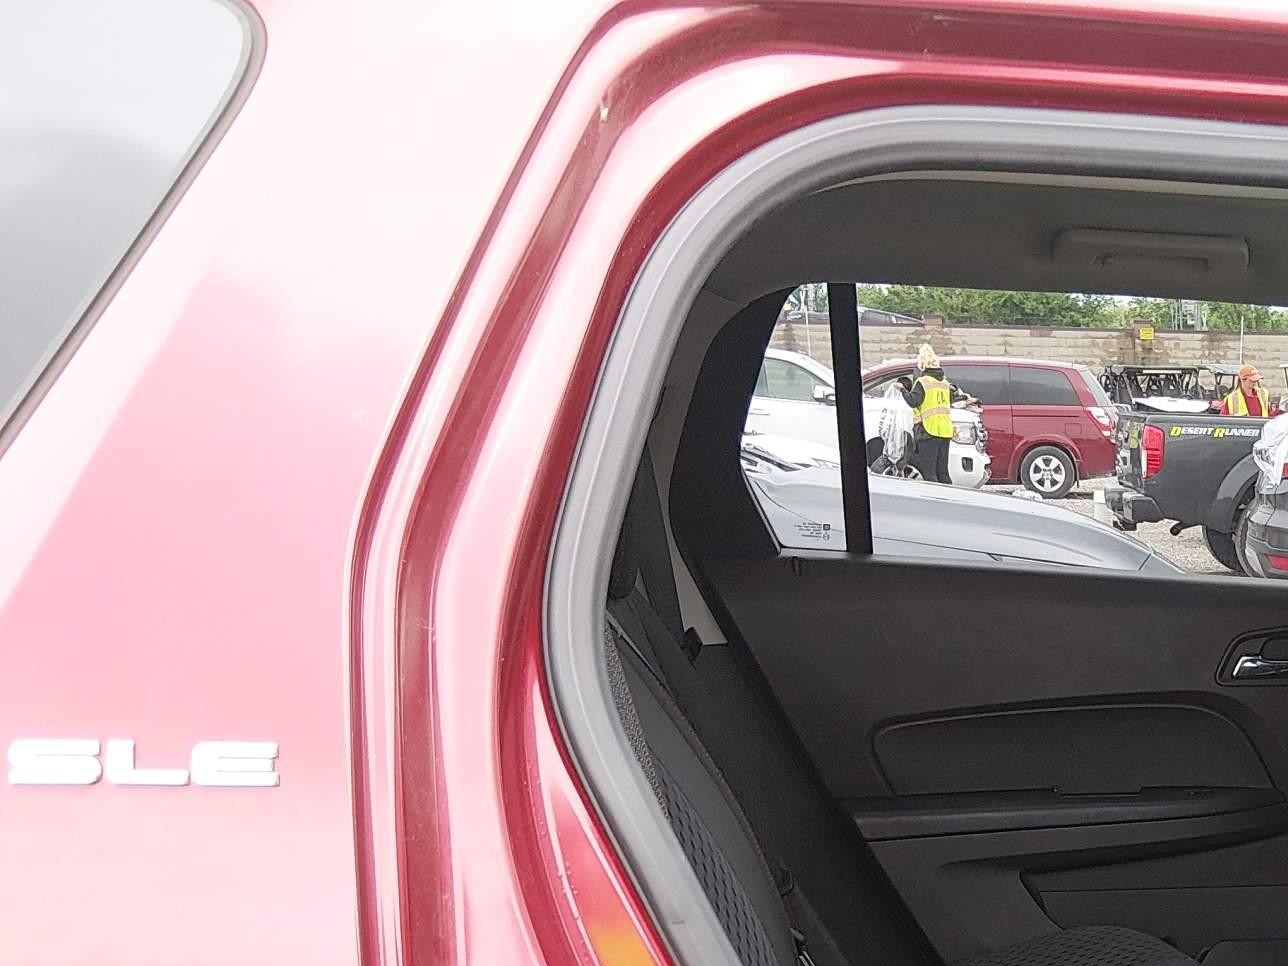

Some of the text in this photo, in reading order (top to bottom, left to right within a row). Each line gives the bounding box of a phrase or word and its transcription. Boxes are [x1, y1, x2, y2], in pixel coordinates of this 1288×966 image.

[1170, 426, 1260, 438] DESERT RUNNER
[8, 738, 280, 787] SLE
